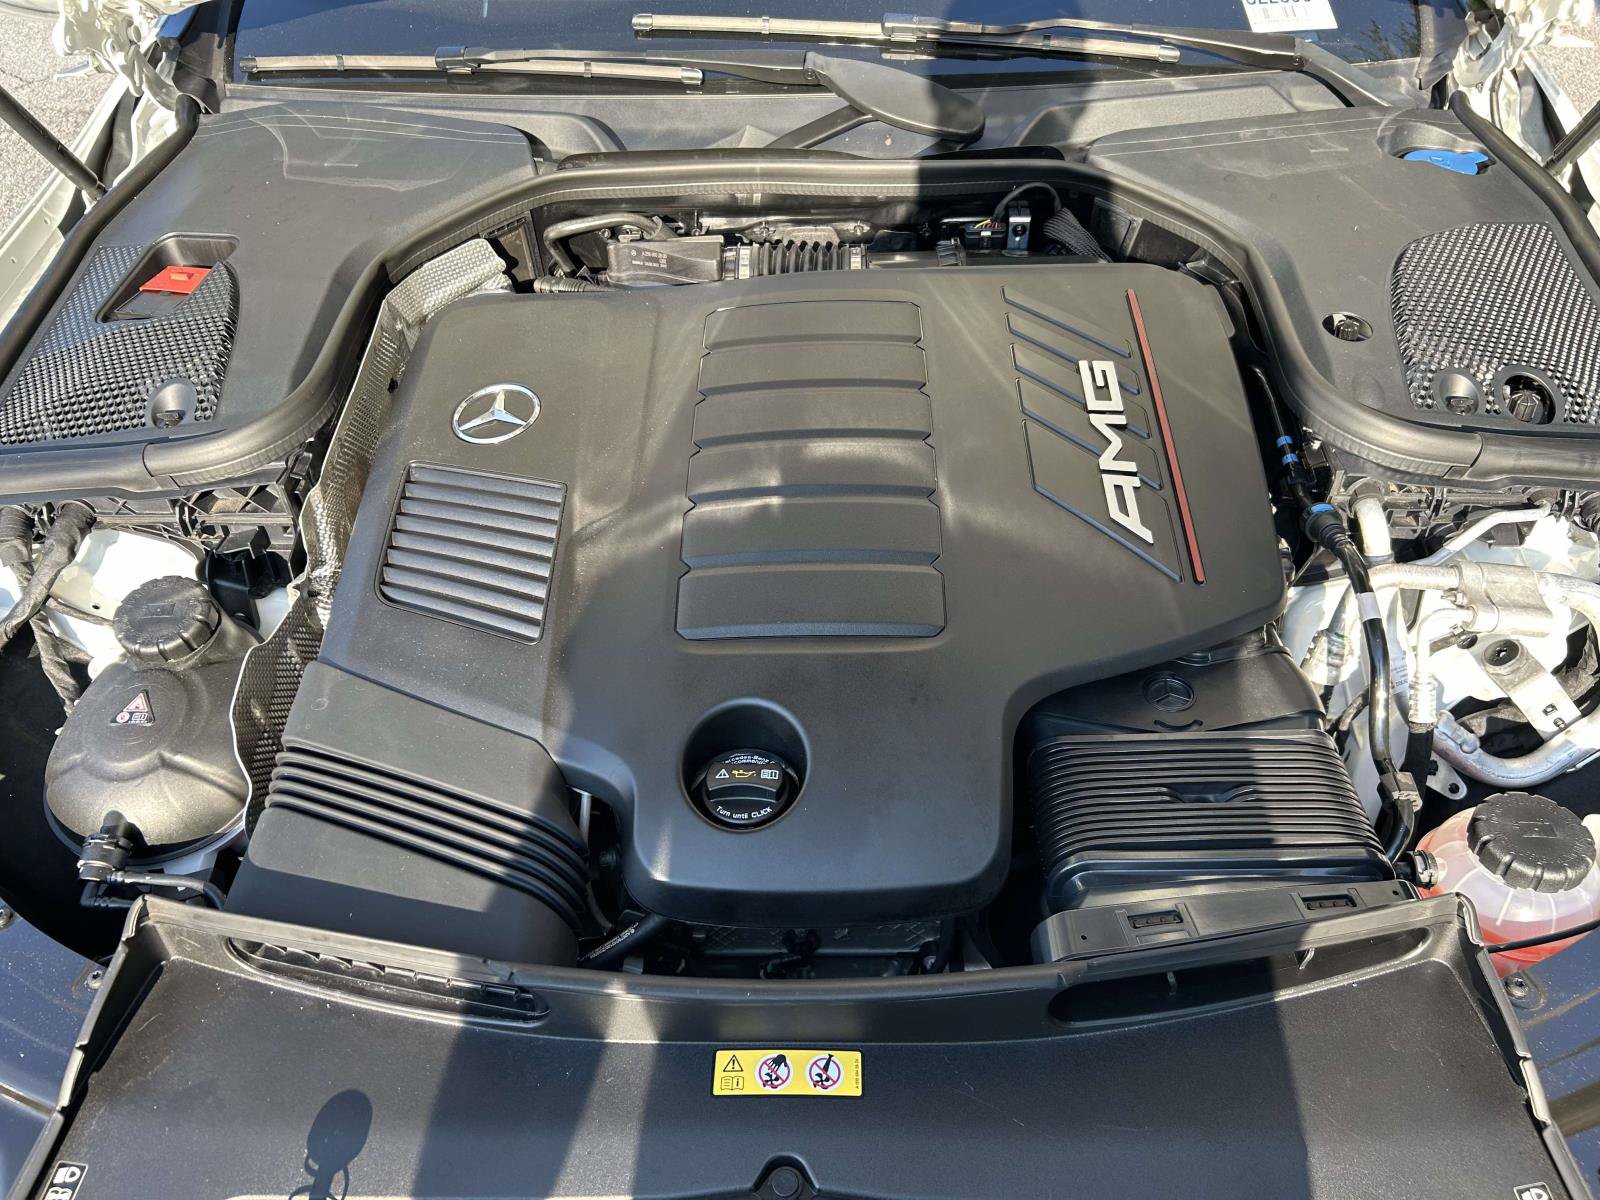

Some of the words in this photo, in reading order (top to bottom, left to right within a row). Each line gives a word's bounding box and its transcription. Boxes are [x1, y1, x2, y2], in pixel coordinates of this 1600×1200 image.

[1078, 360, 1154, 545] AMG
[716, 806, 731, 817] Turn
[751, 807, 773, 818] CLICK
